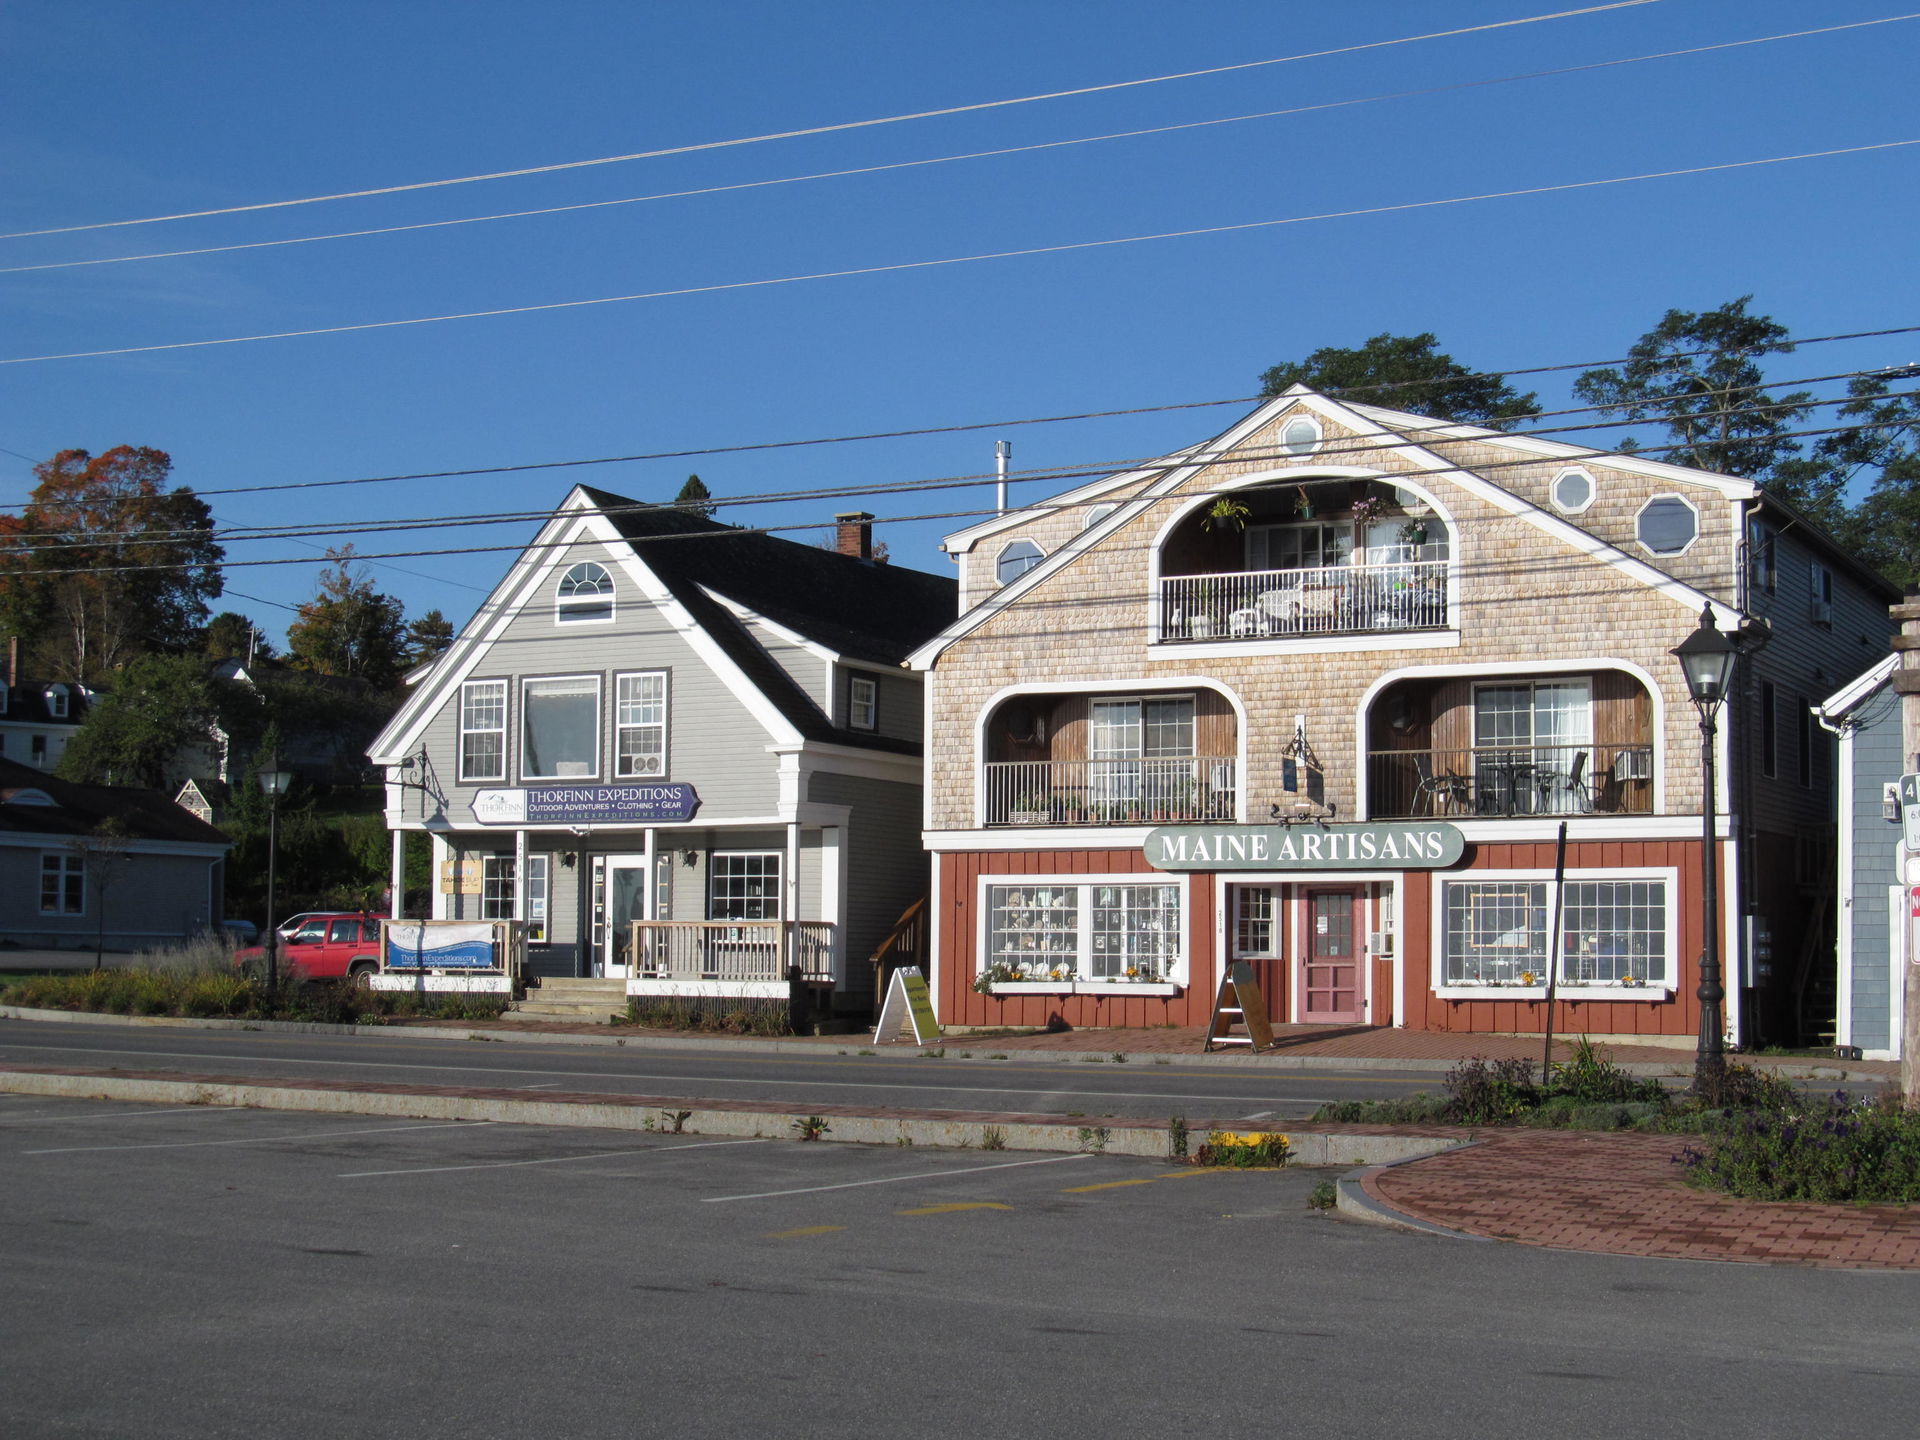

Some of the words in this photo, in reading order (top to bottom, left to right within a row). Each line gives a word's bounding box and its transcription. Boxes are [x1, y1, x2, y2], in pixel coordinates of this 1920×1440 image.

[529, 789, 593, 803] THORFINN
[598, 787, 682, 801] EXPEDITIONS
[1906, 784, 1915, 798] 4
[528, 804, 562, 812] OUTDOOR
[565, 802, 610, 811] ADVENTURES
[617, 801, 653, 809] CLOTHING
[661, 800, 682, 808] GEAR
[1160, 834, 1269, 862] MAINE
[1277, 831, 1444, 861] ARTISANS
[401, 954, 477, 963] ThorfnExpeditions.com
